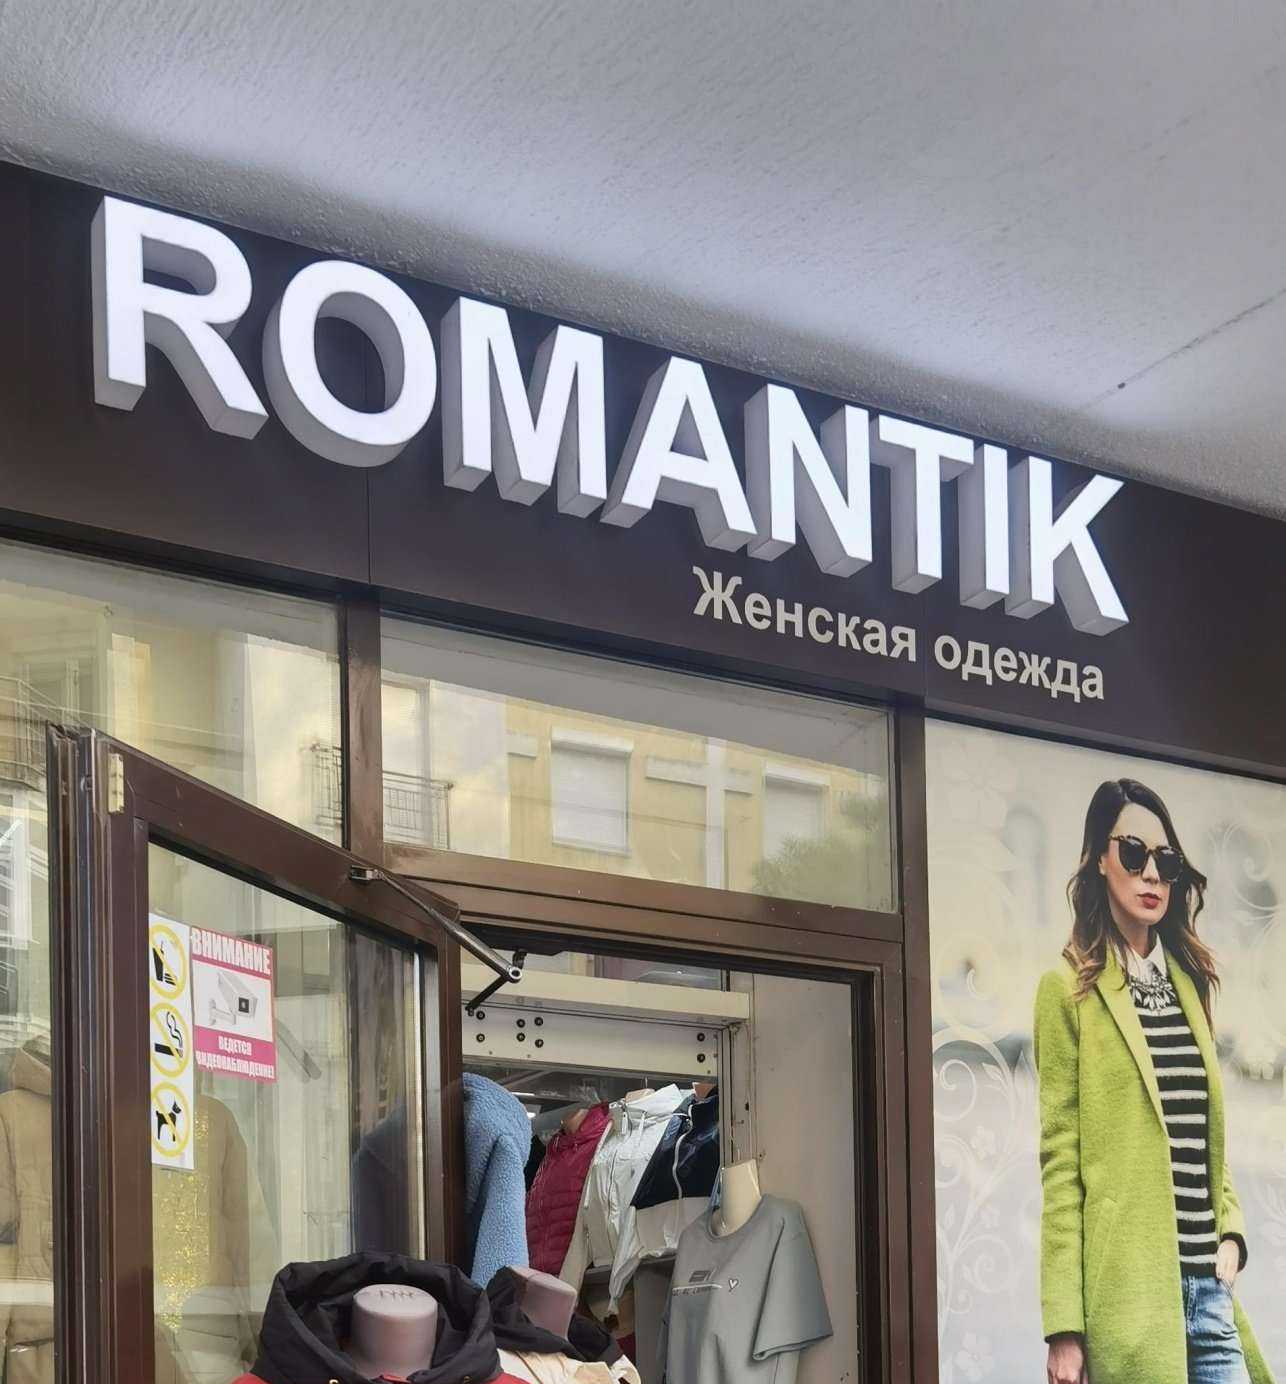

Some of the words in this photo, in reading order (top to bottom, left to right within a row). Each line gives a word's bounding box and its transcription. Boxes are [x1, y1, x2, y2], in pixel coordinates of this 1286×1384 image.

[100, 196, 1129, 627] ROMANTIK
[692, 565, 917, 663] Женская
[934, 634, 1105, 704] одежда
[191, 927, 271, 976] ВНИМАНИЕ
[218, 1035, 253, 1056] ВЕДЕТСЯ
